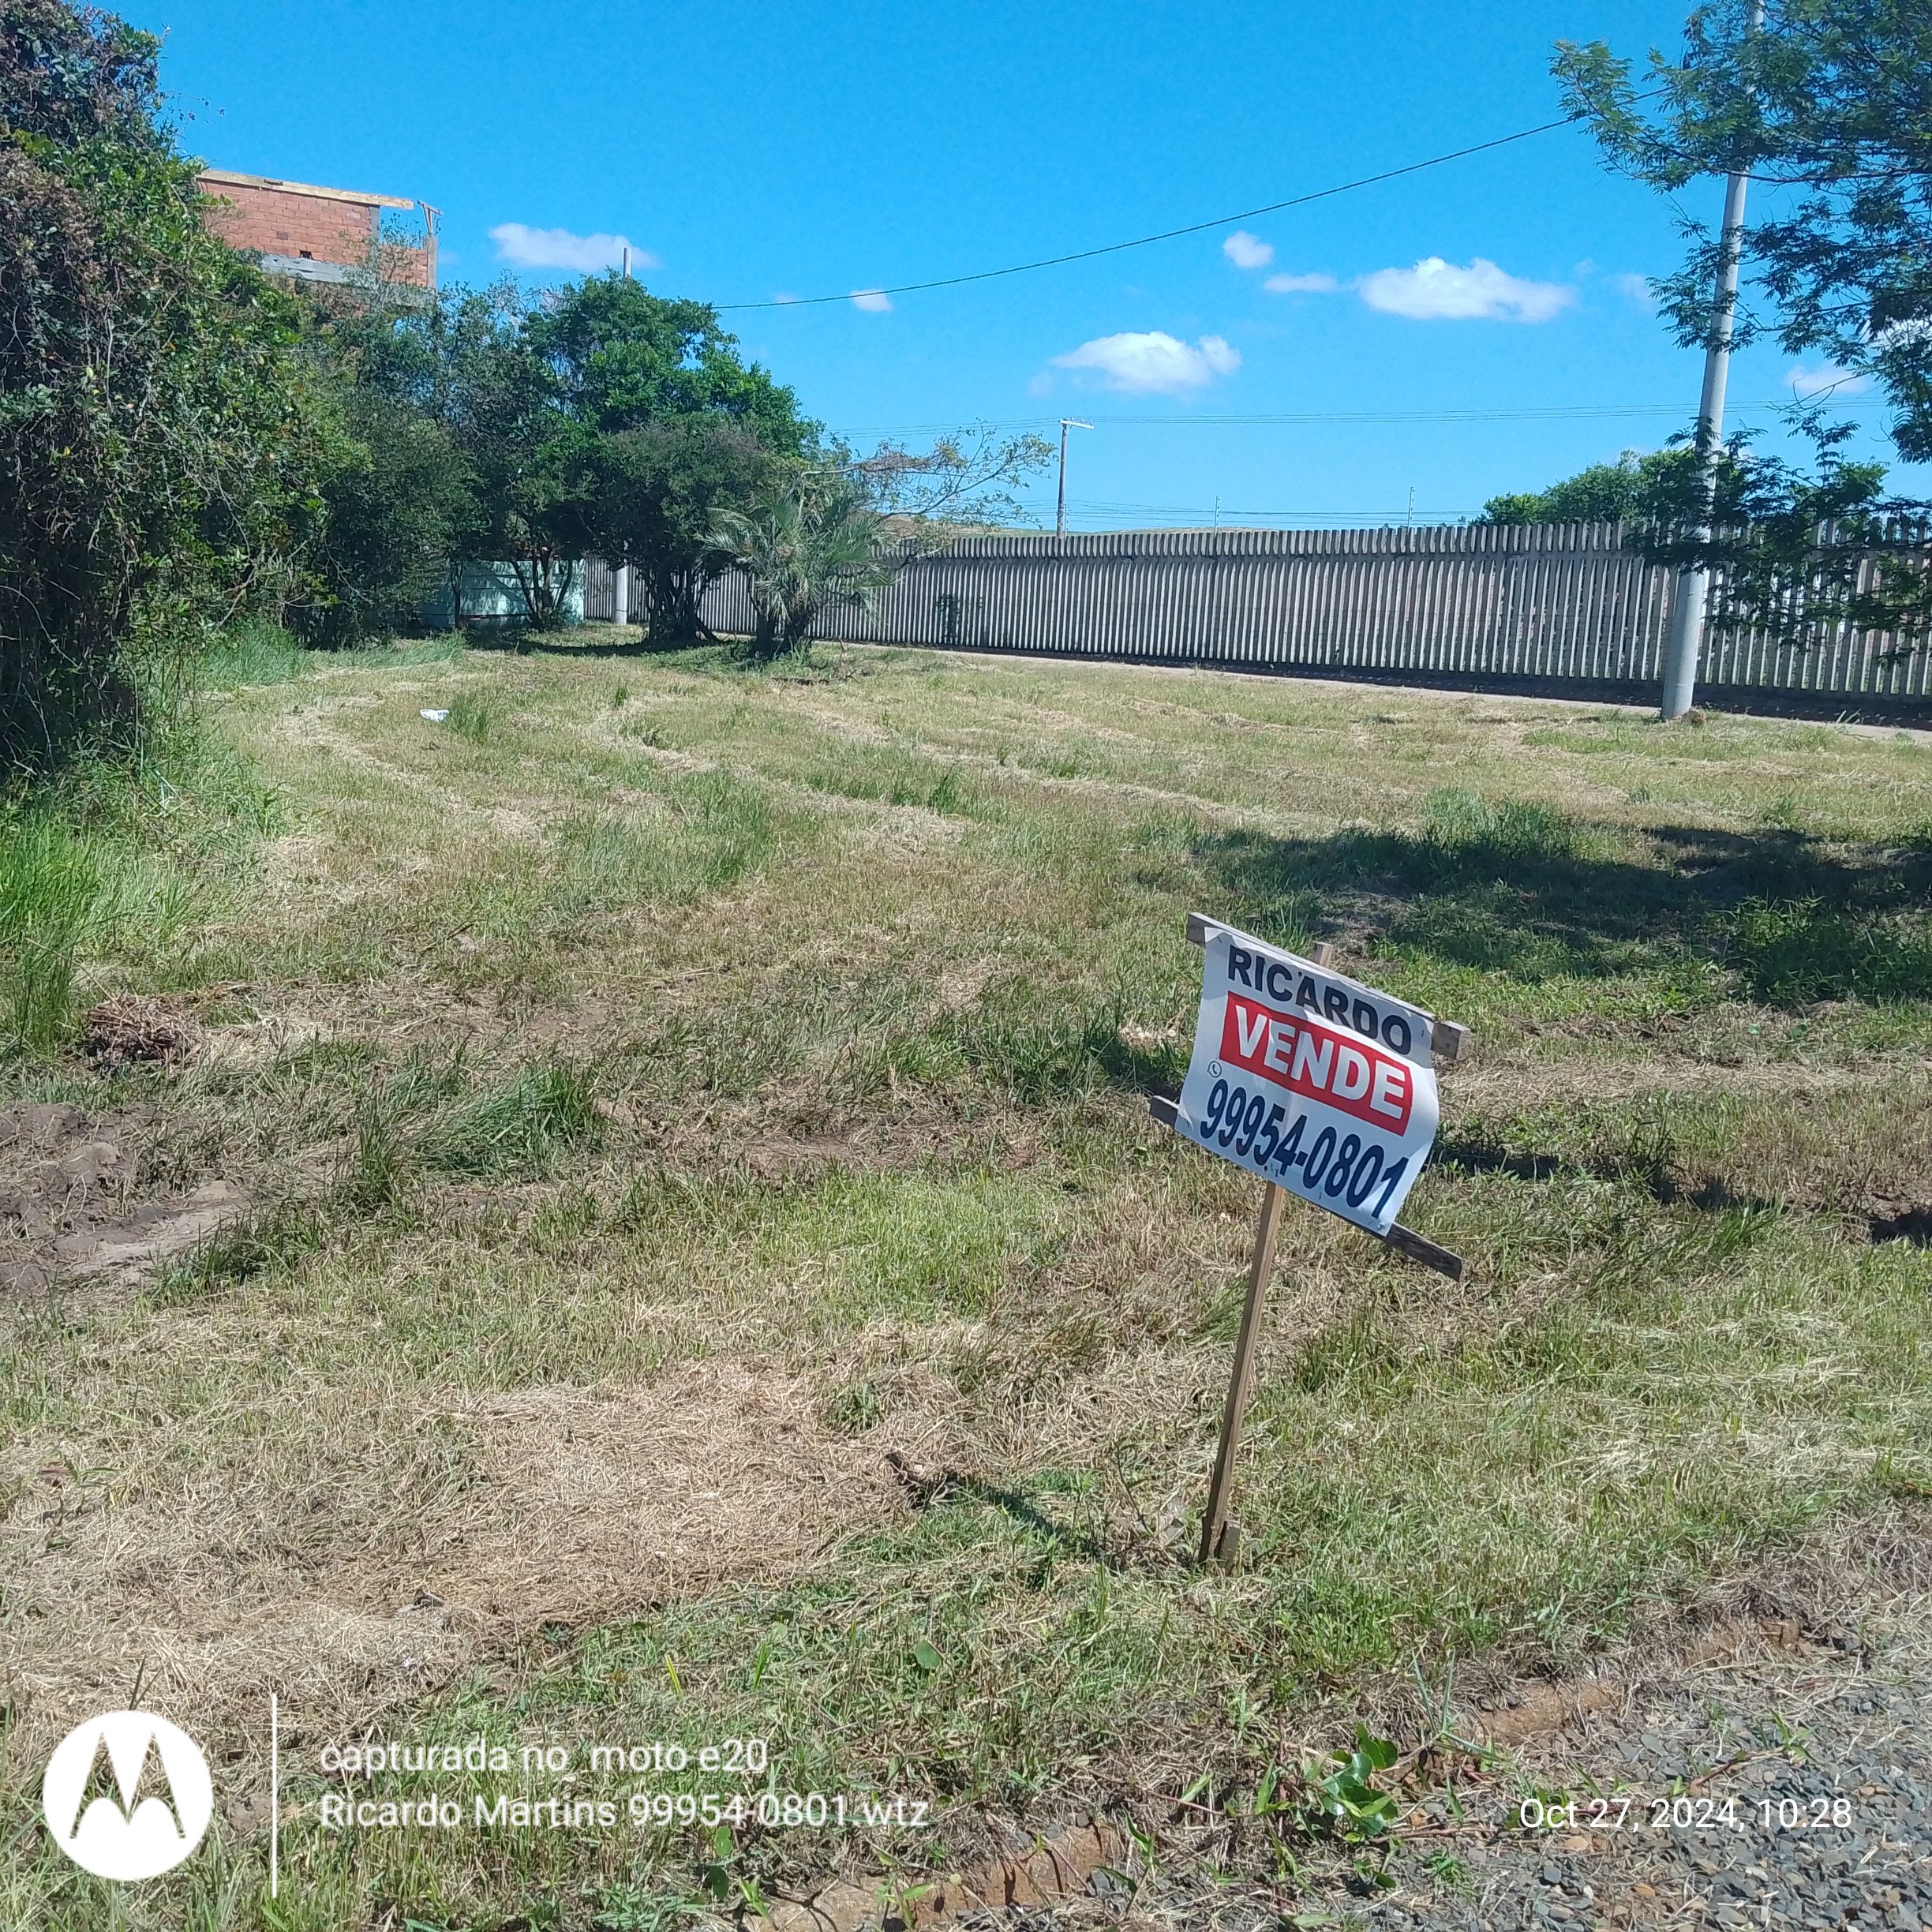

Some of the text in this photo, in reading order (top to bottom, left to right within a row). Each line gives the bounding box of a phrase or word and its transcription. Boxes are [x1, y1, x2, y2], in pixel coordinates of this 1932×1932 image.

[1227, 945, 1412, 1054] RICARDO
[1235, 1005, 1406, 1120] VENDE
[1200, 1079, 1409, 1219] 99954-0801
